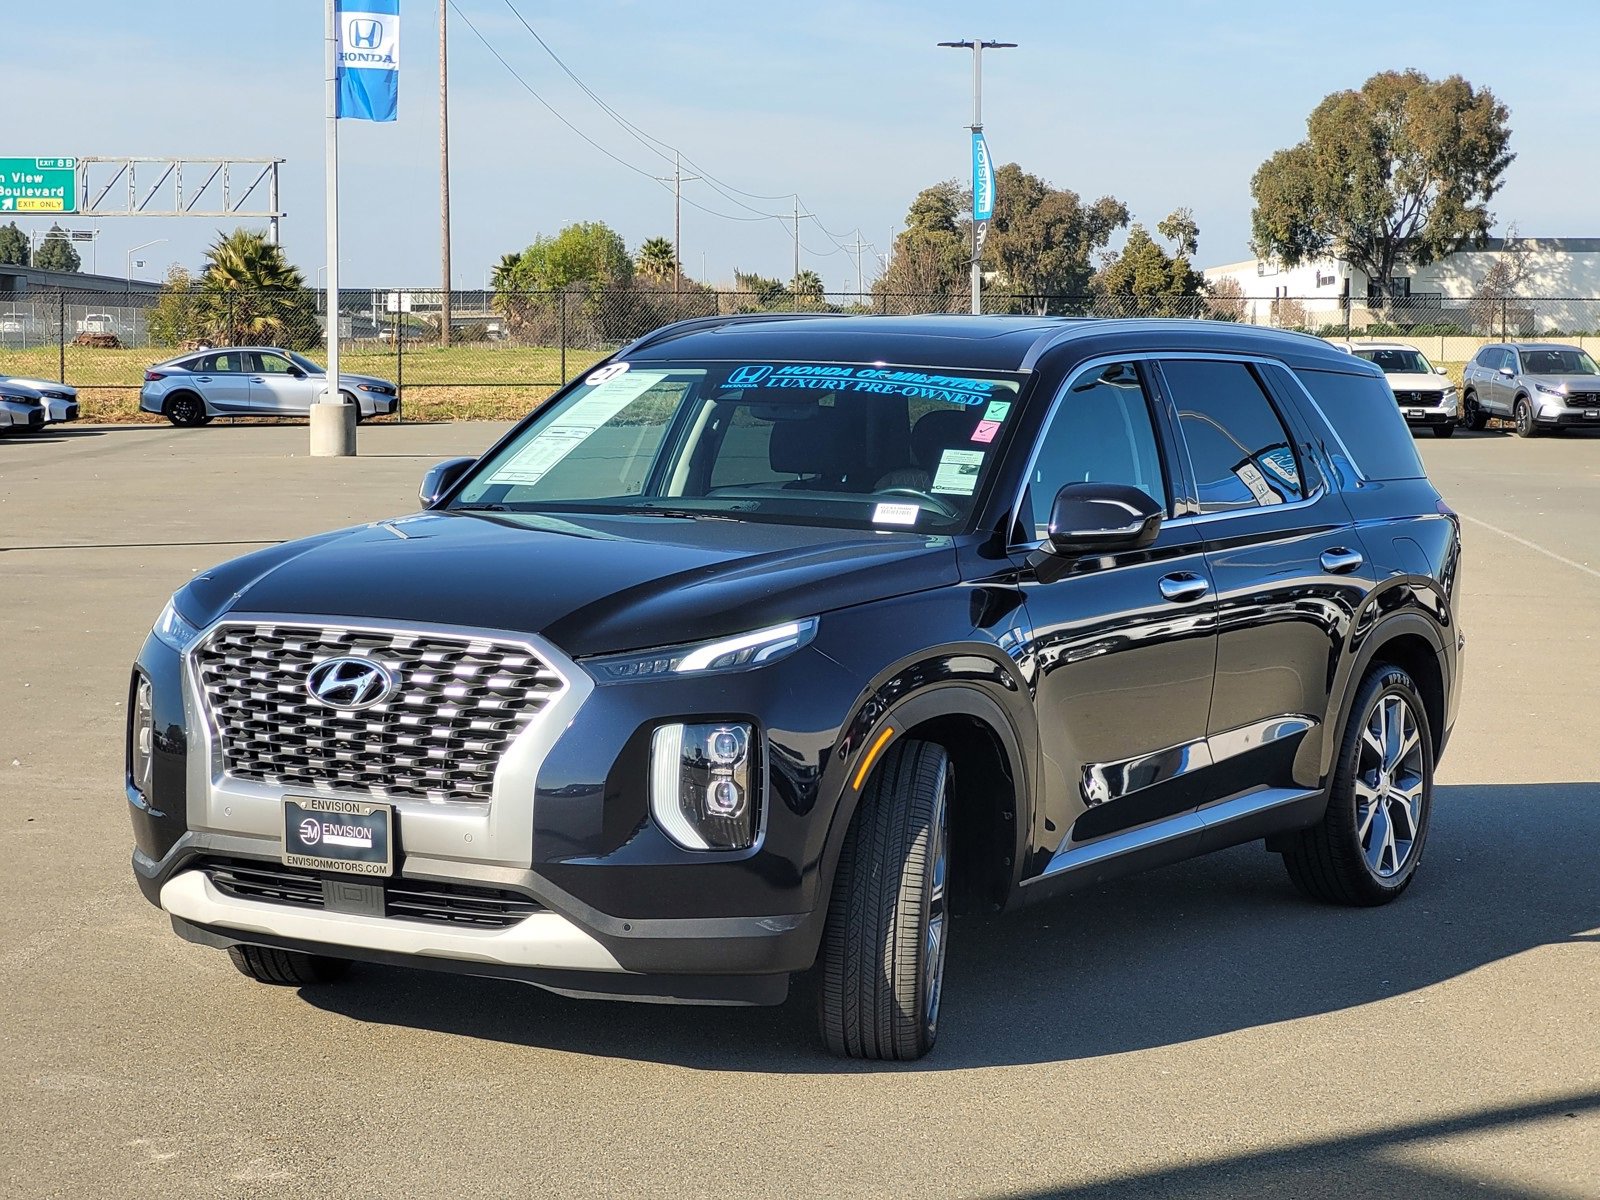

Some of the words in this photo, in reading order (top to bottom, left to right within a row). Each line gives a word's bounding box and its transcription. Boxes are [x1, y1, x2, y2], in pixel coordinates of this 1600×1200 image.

[339, 52, 396, 63] HONDA
[12, 172, 44, 183] View
[976, 140, 988, 213] ENVISION
[776, 366, 854, 377] HONDA
[765, 378, 853, 391] LUXURY
[852, 382, 984, 406] PRE-OWNED
[311, 800, 360, 813] ENVISION
[322, 823, 372, 839] ENVISION
[287, 856, 387, 874] ENVISIONMOTORS.COM
